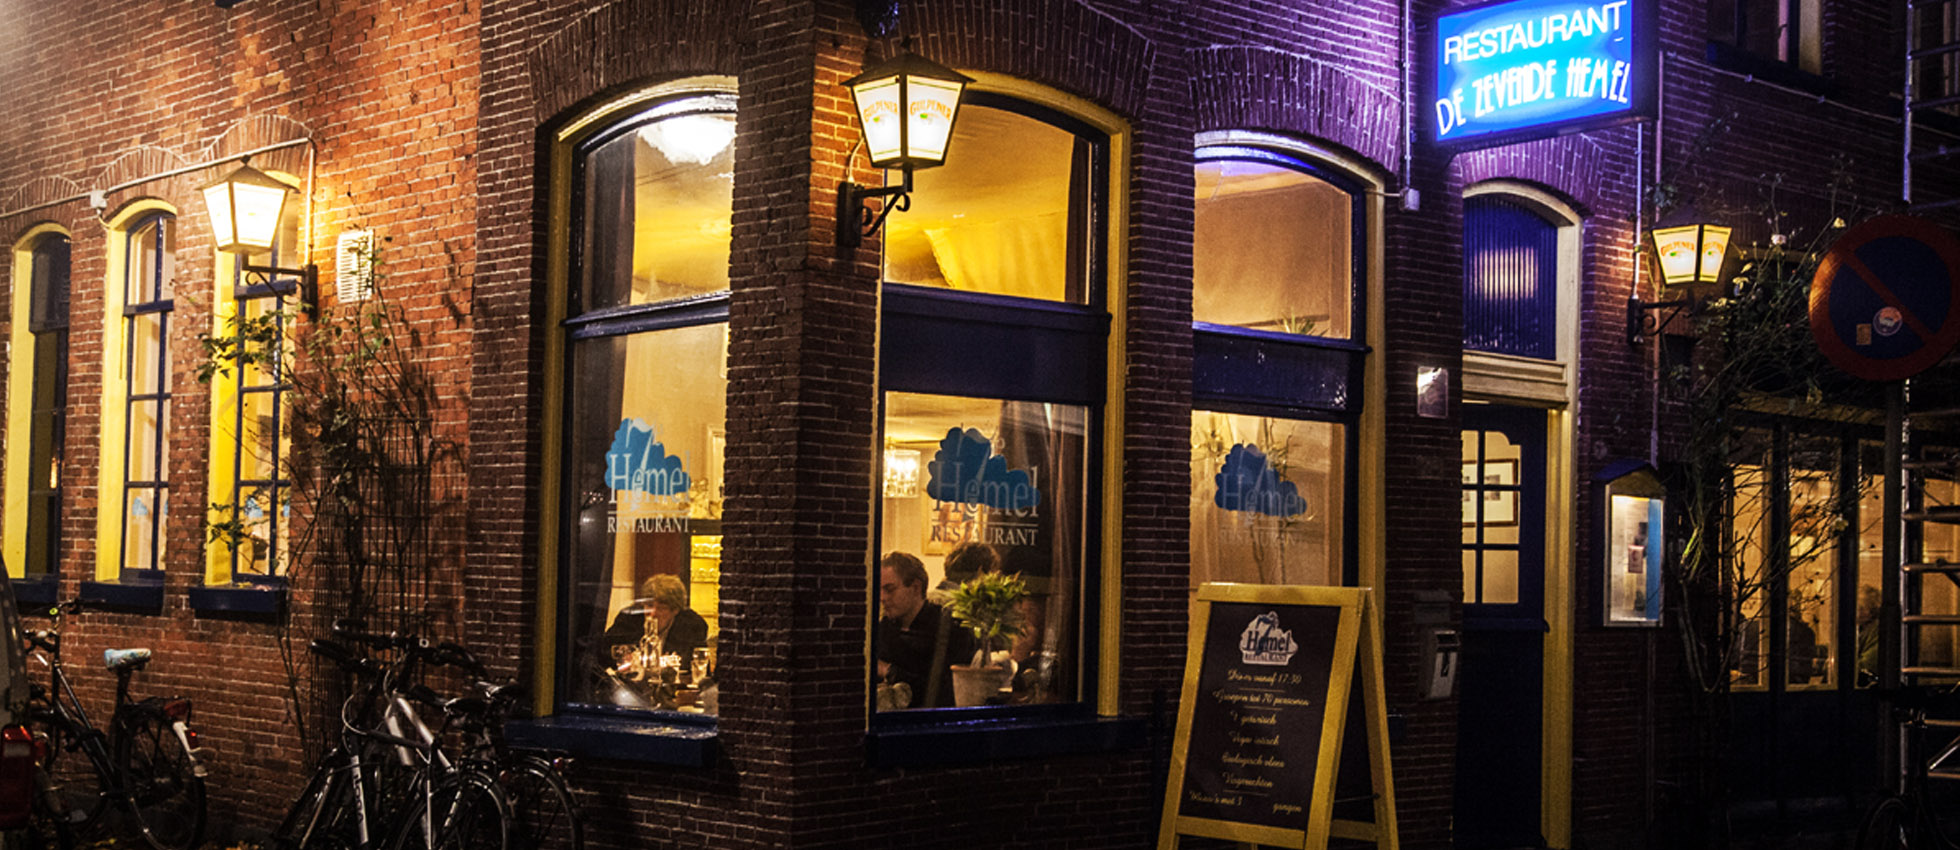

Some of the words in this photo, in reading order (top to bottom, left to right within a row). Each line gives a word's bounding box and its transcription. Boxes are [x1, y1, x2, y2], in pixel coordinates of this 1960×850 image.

[1444, 0, 1628, 64] RESTAURANT
[1436, 88, 1467, 136] DE
[1471, 60, 1557, 118] ZEVENDE
[1566, 57, 1631, 103] HEMEL
[608, 450, 691, 504] Hemel
[932, 462, 1039, 518] Hemel
[607, 516, 689, 533] RESTAURANT
[931, 525, 1038, 546] RESTAURANT
[1245, 630, 1291, 651] Hemel
